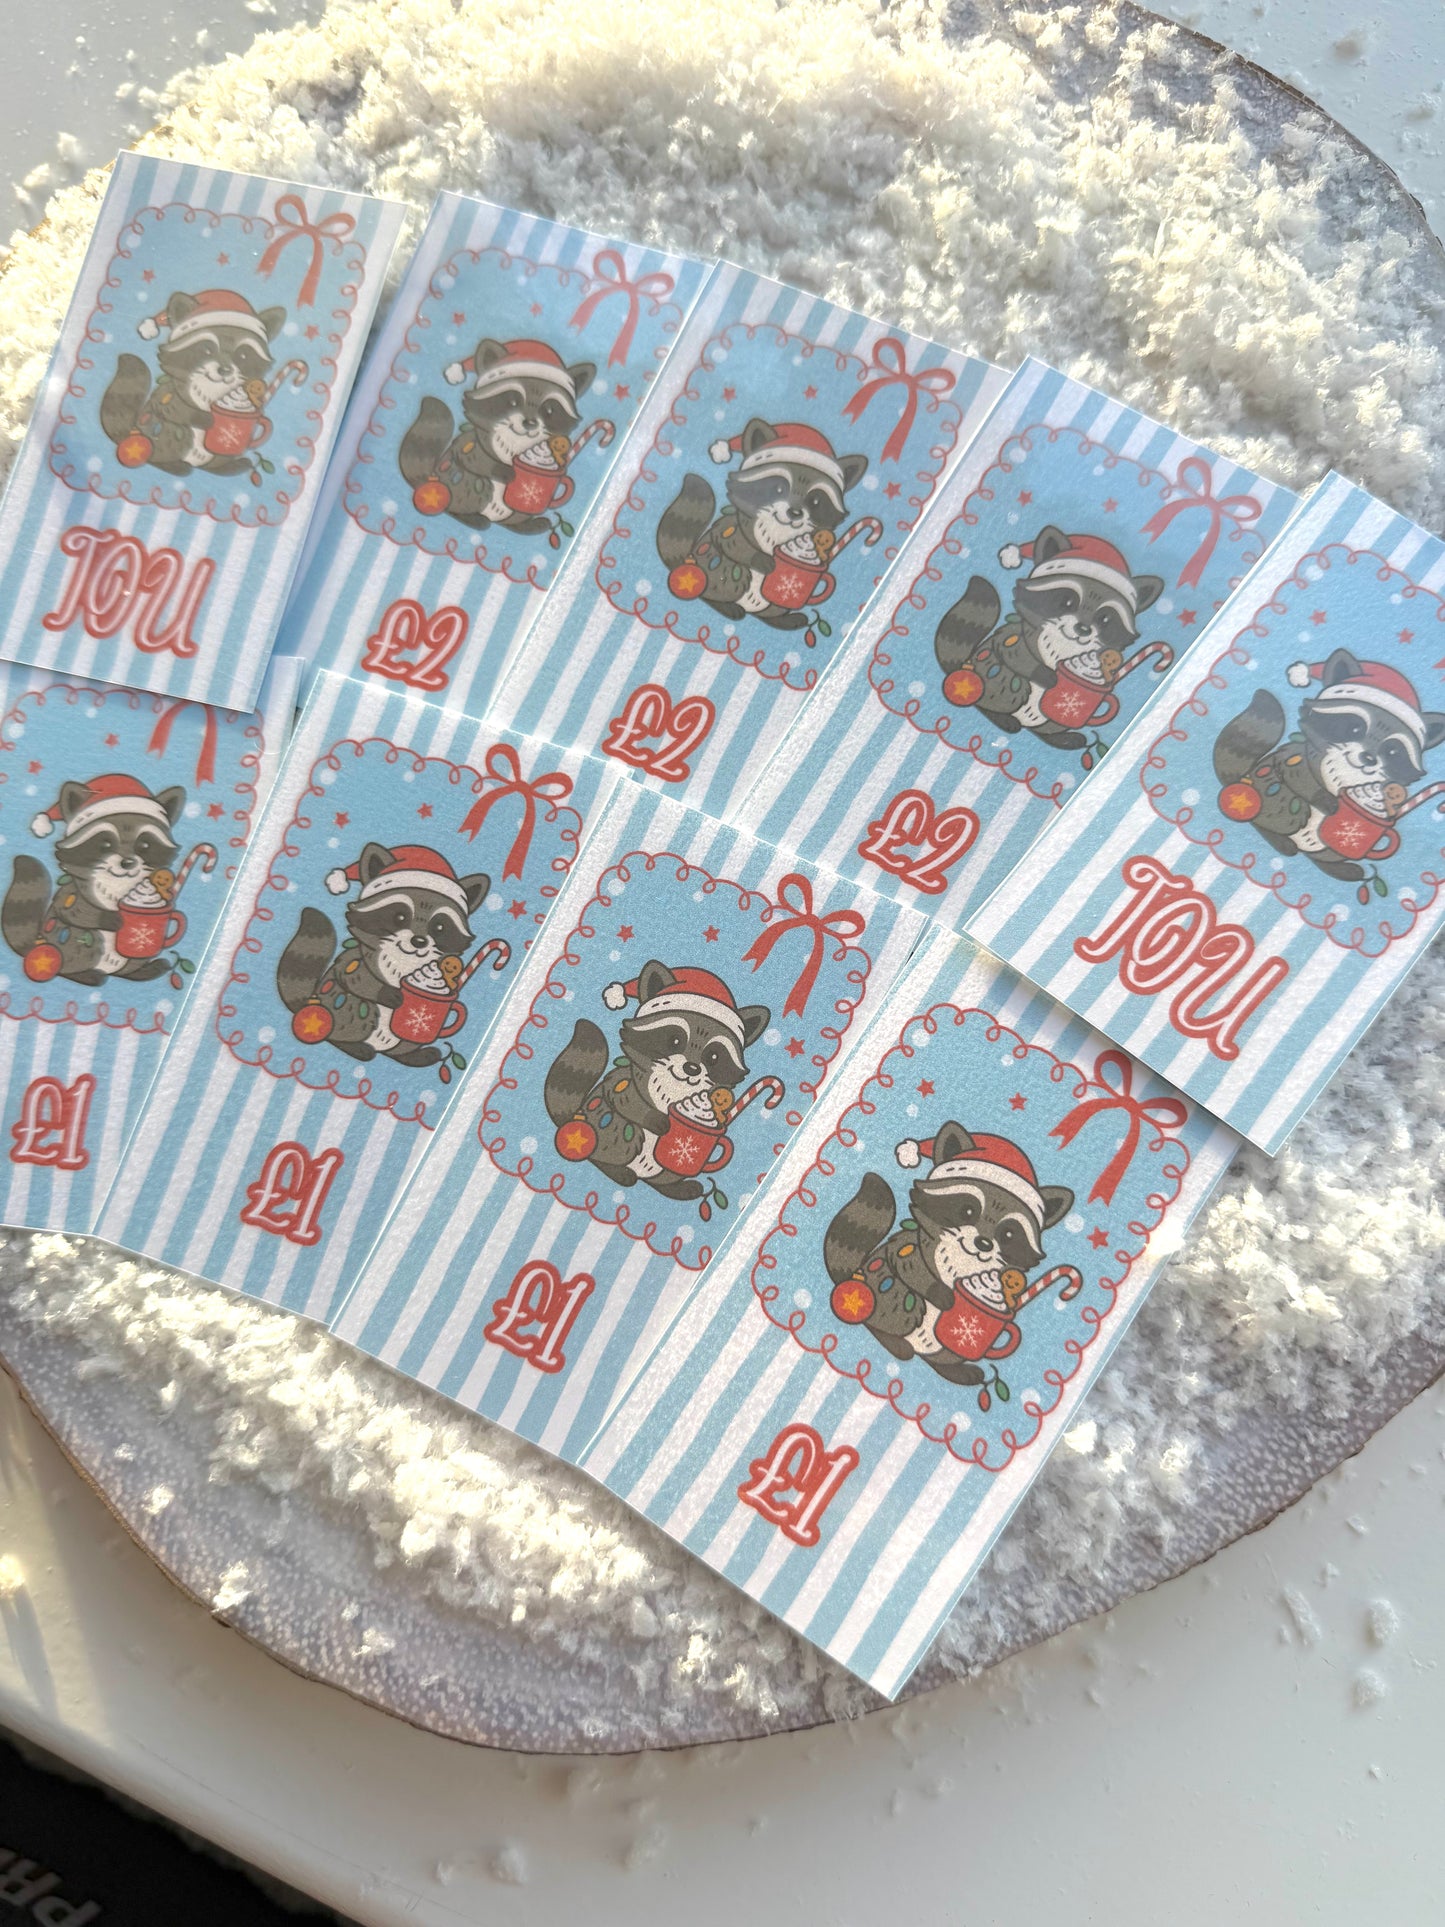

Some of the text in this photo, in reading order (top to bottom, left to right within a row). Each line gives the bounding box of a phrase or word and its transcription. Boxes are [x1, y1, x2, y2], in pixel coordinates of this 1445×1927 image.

[361, 599, 468, 691] £2
[602, 684, 716, 783] £2
[858, 789, 981, 895] £2
[10, 1073, 97, 1170] £1
[240, 1141, 344, 1247] £1
[483, 1260, 595, 1373] £1
[738, 1423, 860, 1547] £1
